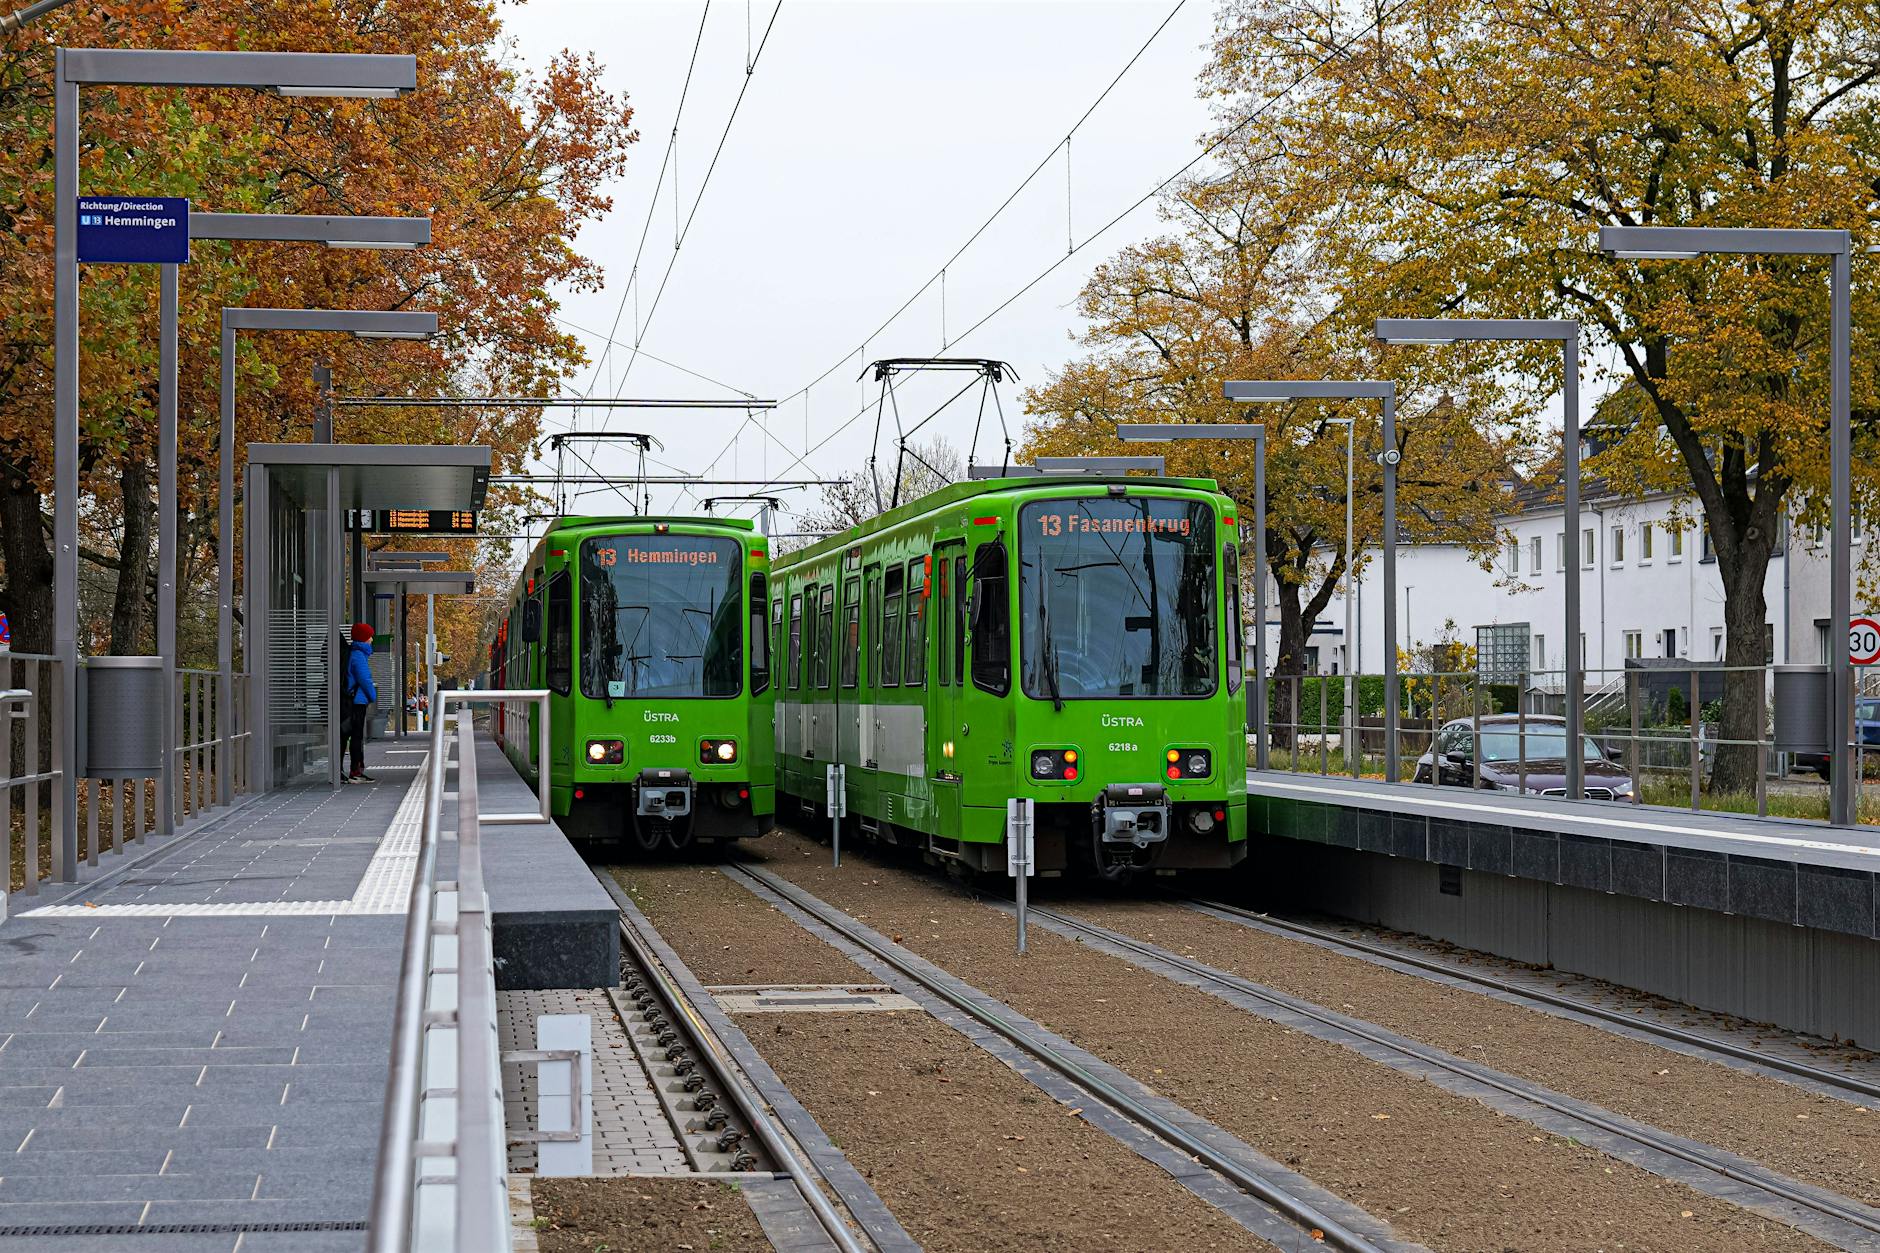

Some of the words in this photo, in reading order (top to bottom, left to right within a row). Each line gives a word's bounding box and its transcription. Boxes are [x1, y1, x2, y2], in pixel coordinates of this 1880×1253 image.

[80, 201, 164, 212] Richtung/Direction
[81, 215, 91, 225] U
[93, 216, 102, 225] 13
[104, 215, 176, 229] Hemmingen
[1037, 514, 1062, 536] 13
[1068, 514, 1191, 537] Fasanenkrug
[597, 548, 617, 566] 13
[627, 548, 718, 566] Hemmingen
[1850, 632, 1876, 652] 30
[643, 710, 679, 722] ÜSTRA
[1101, 713, 1144, 727] ÜSTRA
[650, 735, 676, 743] 6233b
